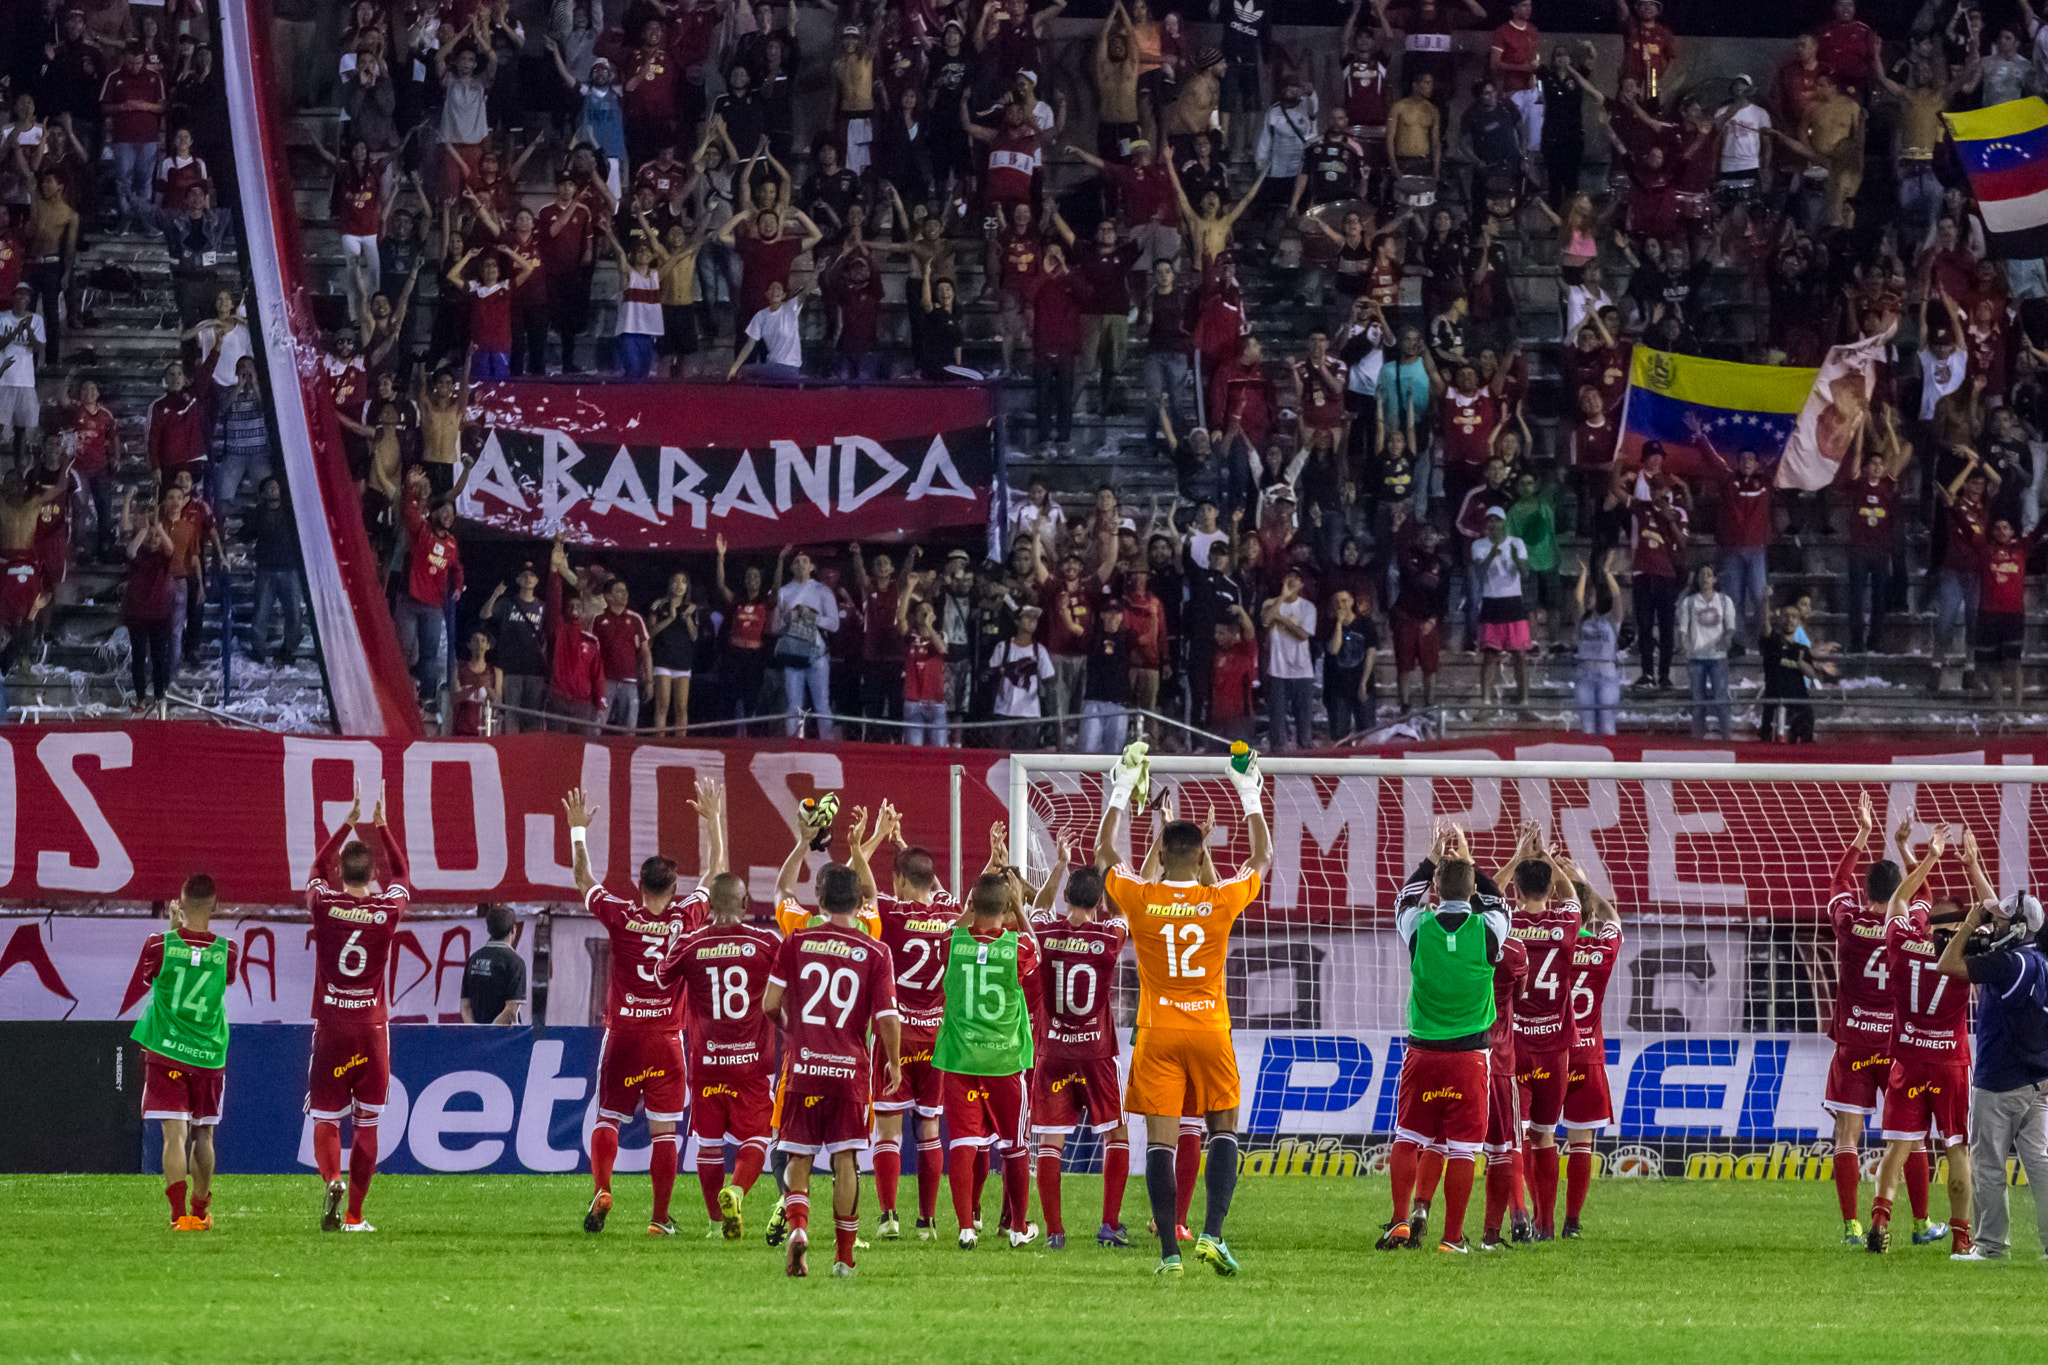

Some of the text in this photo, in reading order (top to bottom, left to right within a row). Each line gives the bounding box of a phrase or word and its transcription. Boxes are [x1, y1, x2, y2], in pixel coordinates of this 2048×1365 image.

[1230, 21, 1258, 37] adidas
[456, 426, 977, 530] ABARANDA
[0, 731, 134, 893] S
[283, 735, 844, 897] ROJOS
[338, 929, 368, 977] 6
[637, 935, 665, 982] 3
[1159, 923, 1206, 978] 12
[1864, 946, 1890, 991] 4
[170, 965, 213, 1022] 14
[338, 997, 378, 1009] DIRECTV
[706, 965, 750, 1020] 18
[799, 961, 860, 1029] 29
[961, 963, 1006, 1021] 15
[1051, 960, 1097, 1016] 10
[1908, 959, 1950, 1015] 17
[635, 1006, 674, 1018] DIRECTV
[1523, 1021, 1563, 1035] DIRECTV
[1860, 1021, 1893, 1033] DIREC
[178, 1041, 217, 1061] DIRECTV
[719, 1051, 760, 1066] DIRECTV
[1062, 1030, 1101, 1043] DIRECTV
[1914, 1038, 1957, 1050] DIRECTV
[809, 1064, 857, 1080] DIRECTV
